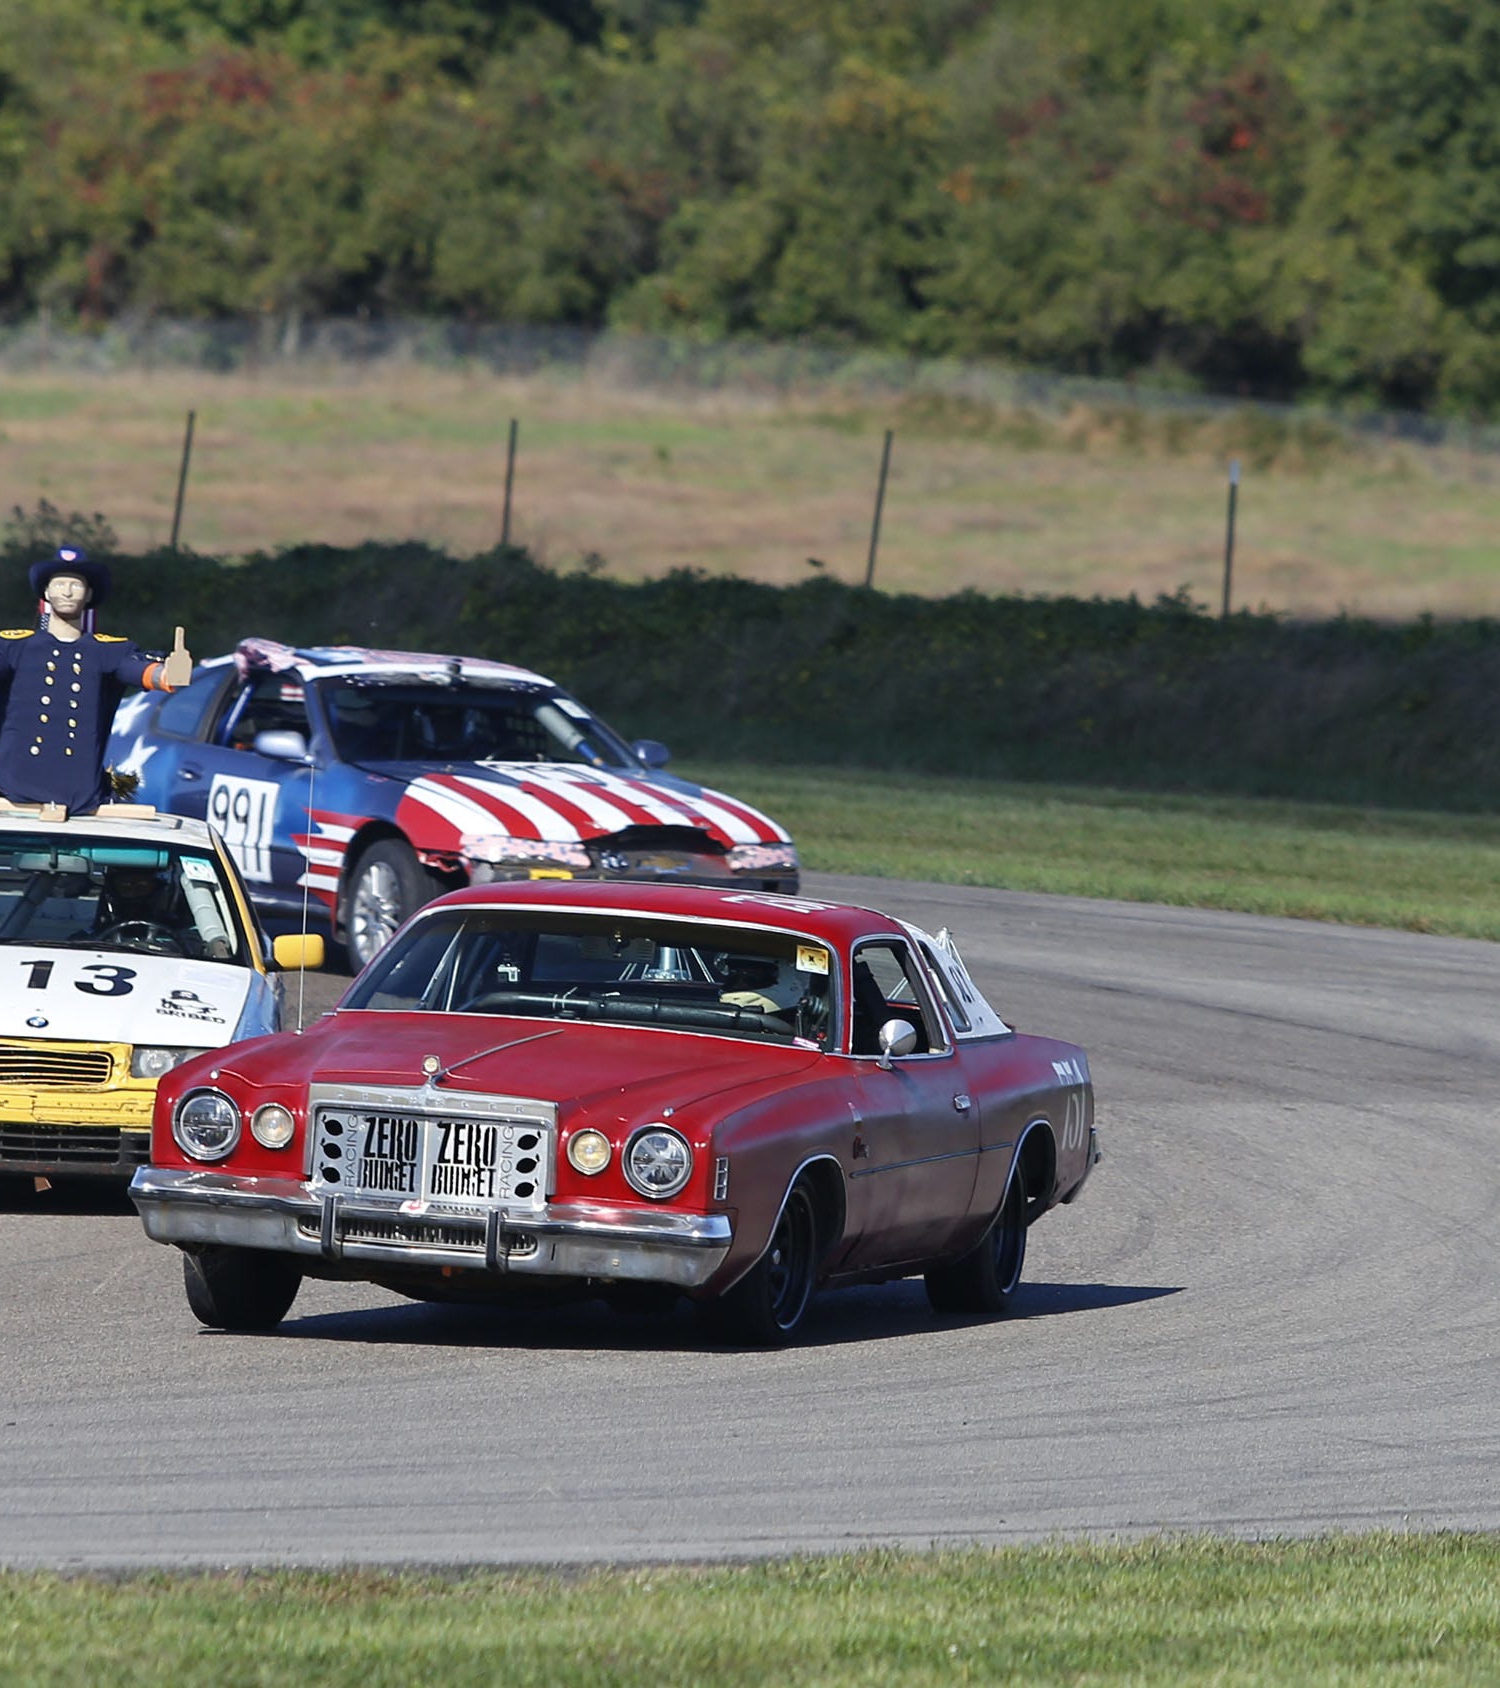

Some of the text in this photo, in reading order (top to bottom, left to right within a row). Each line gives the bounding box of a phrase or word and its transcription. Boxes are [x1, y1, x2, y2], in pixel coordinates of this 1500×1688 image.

[212, 784, 267, 872] 991
[155, 1008, 226, 1025] BRIBED
[344, 1114, 359, 1188] RACING
[363, 1116, 418, 1161] ZERO
[436, 1121, 498, 1167] ZERO
[359, 1158, 417, 1193] BUDGET
[430, 1164, 497, 1198] BUDGET
[500, 1125, 516, 1199] RACING
